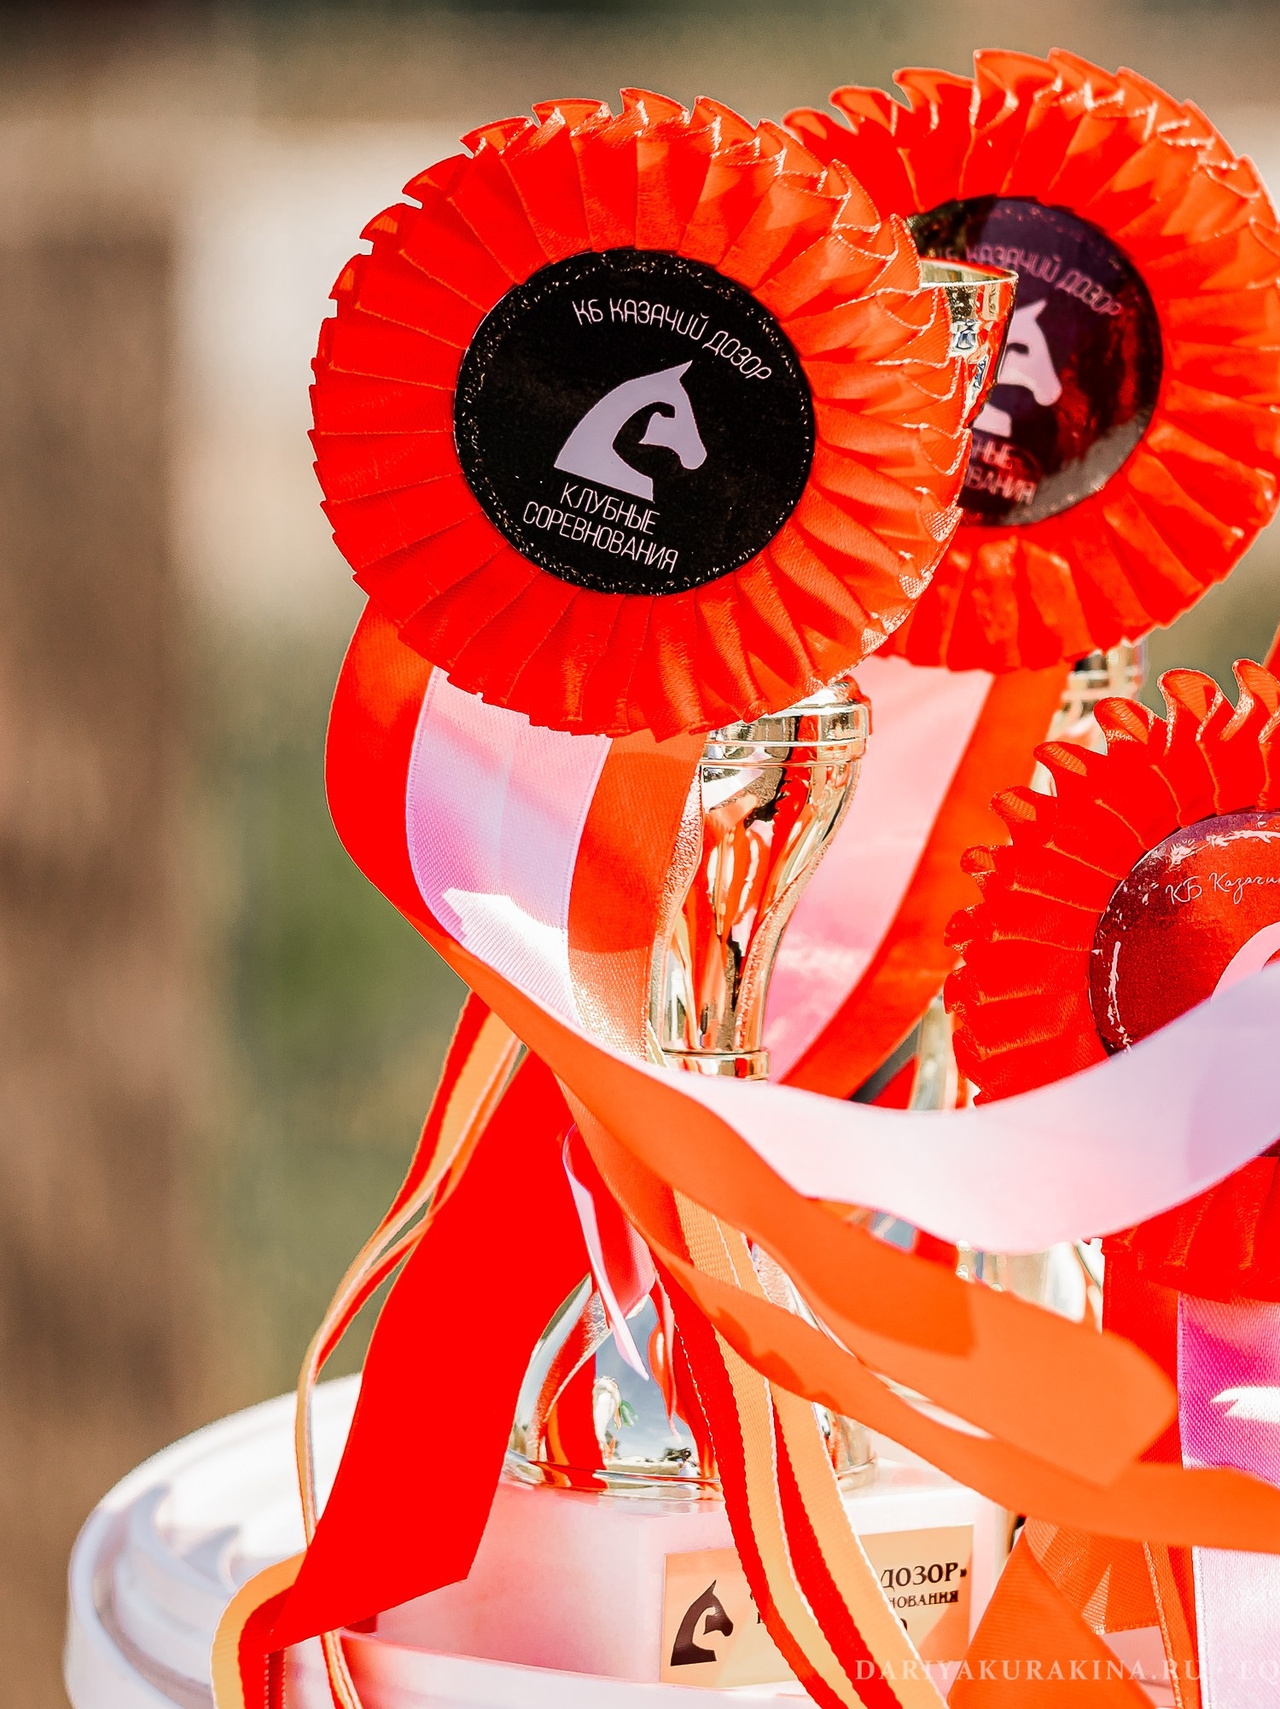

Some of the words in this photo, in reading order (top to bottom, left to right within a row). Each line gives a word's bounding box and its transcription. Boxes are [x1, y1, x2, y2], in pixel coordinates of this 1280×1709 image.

[1056, 270, 1123, 316] ДОЗОР
[572, 299, 604, 325] КБ
[609, 298, 709, 341] КАЗАЧИЙ
[702, 330, 772, 381] ДОЗОР
[560, 482, 661, 535] КЛУБНЫЕ
[522, 501, 679, 573] СОРЕВНОВАНИЯ
[1165, 875, 1203, 905] КБ
